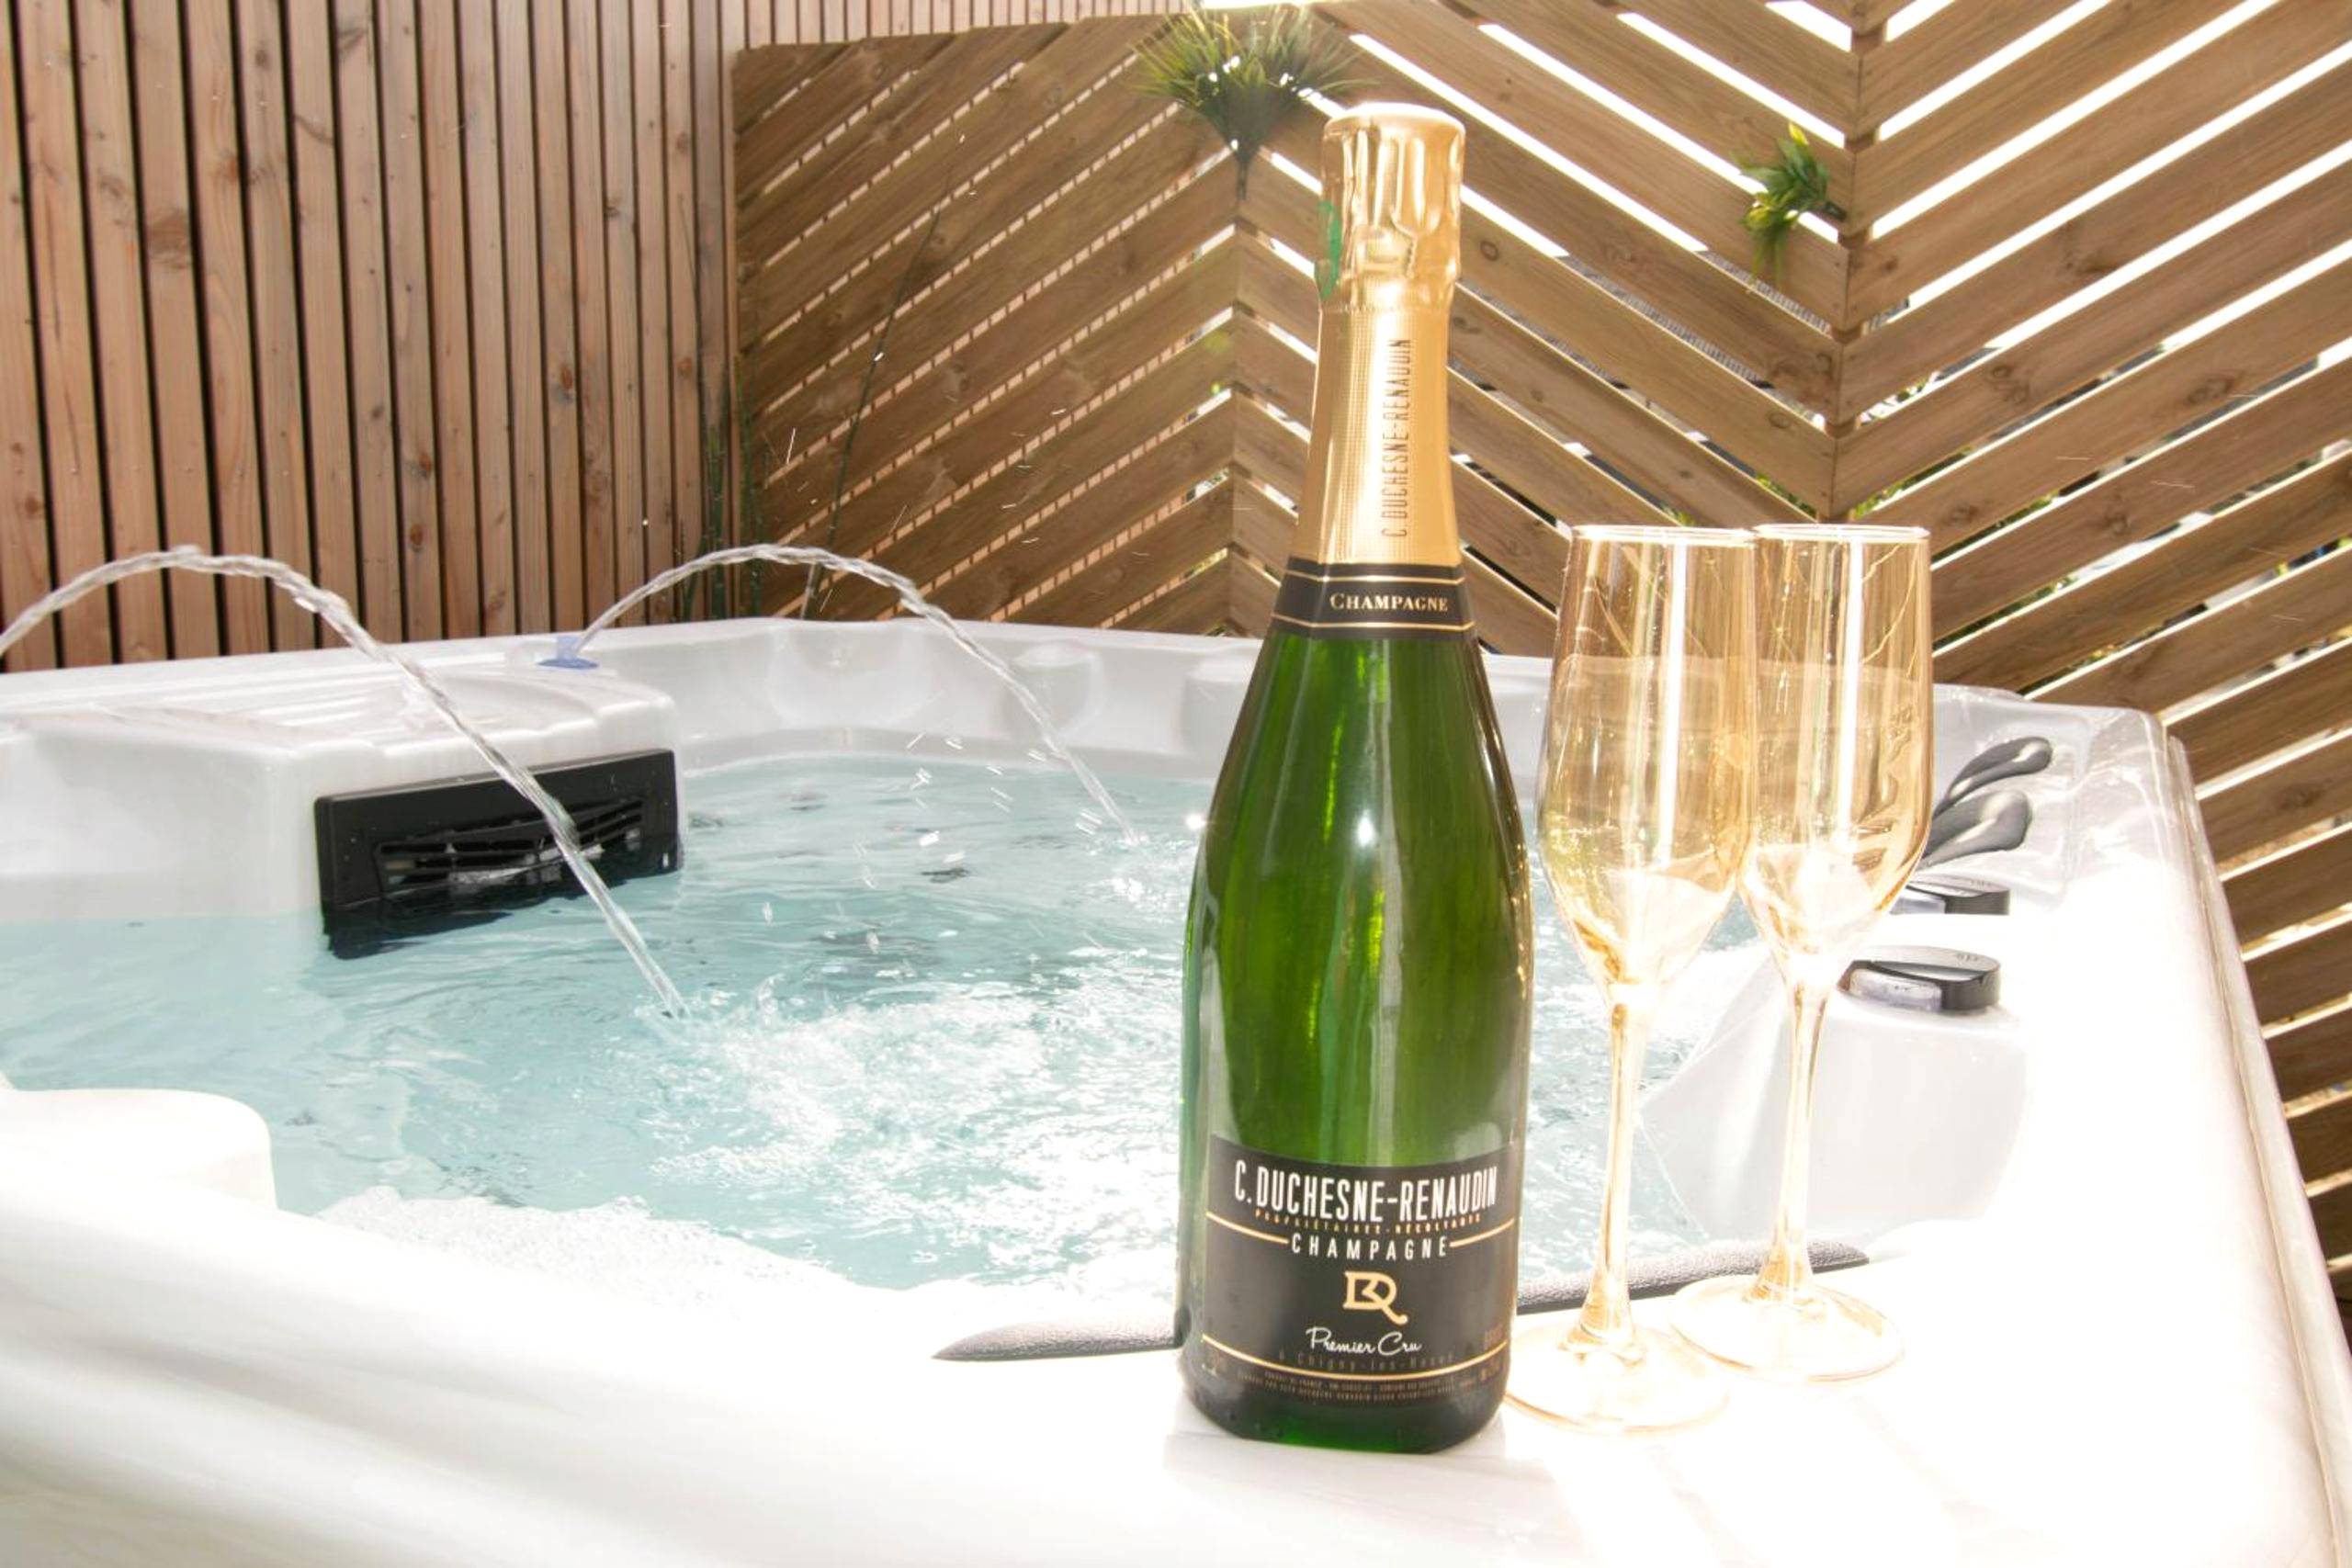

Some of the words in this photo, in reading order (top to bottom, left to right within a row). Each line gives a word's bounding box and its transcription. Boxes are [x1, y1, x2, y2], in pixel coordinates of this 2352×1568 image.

[1292, 1233, 1447, 1261] CHAMPAGNE
[1306, 1326, 1375, 1354] Premier
[1378, 1332, 1422, 1356] Cru
